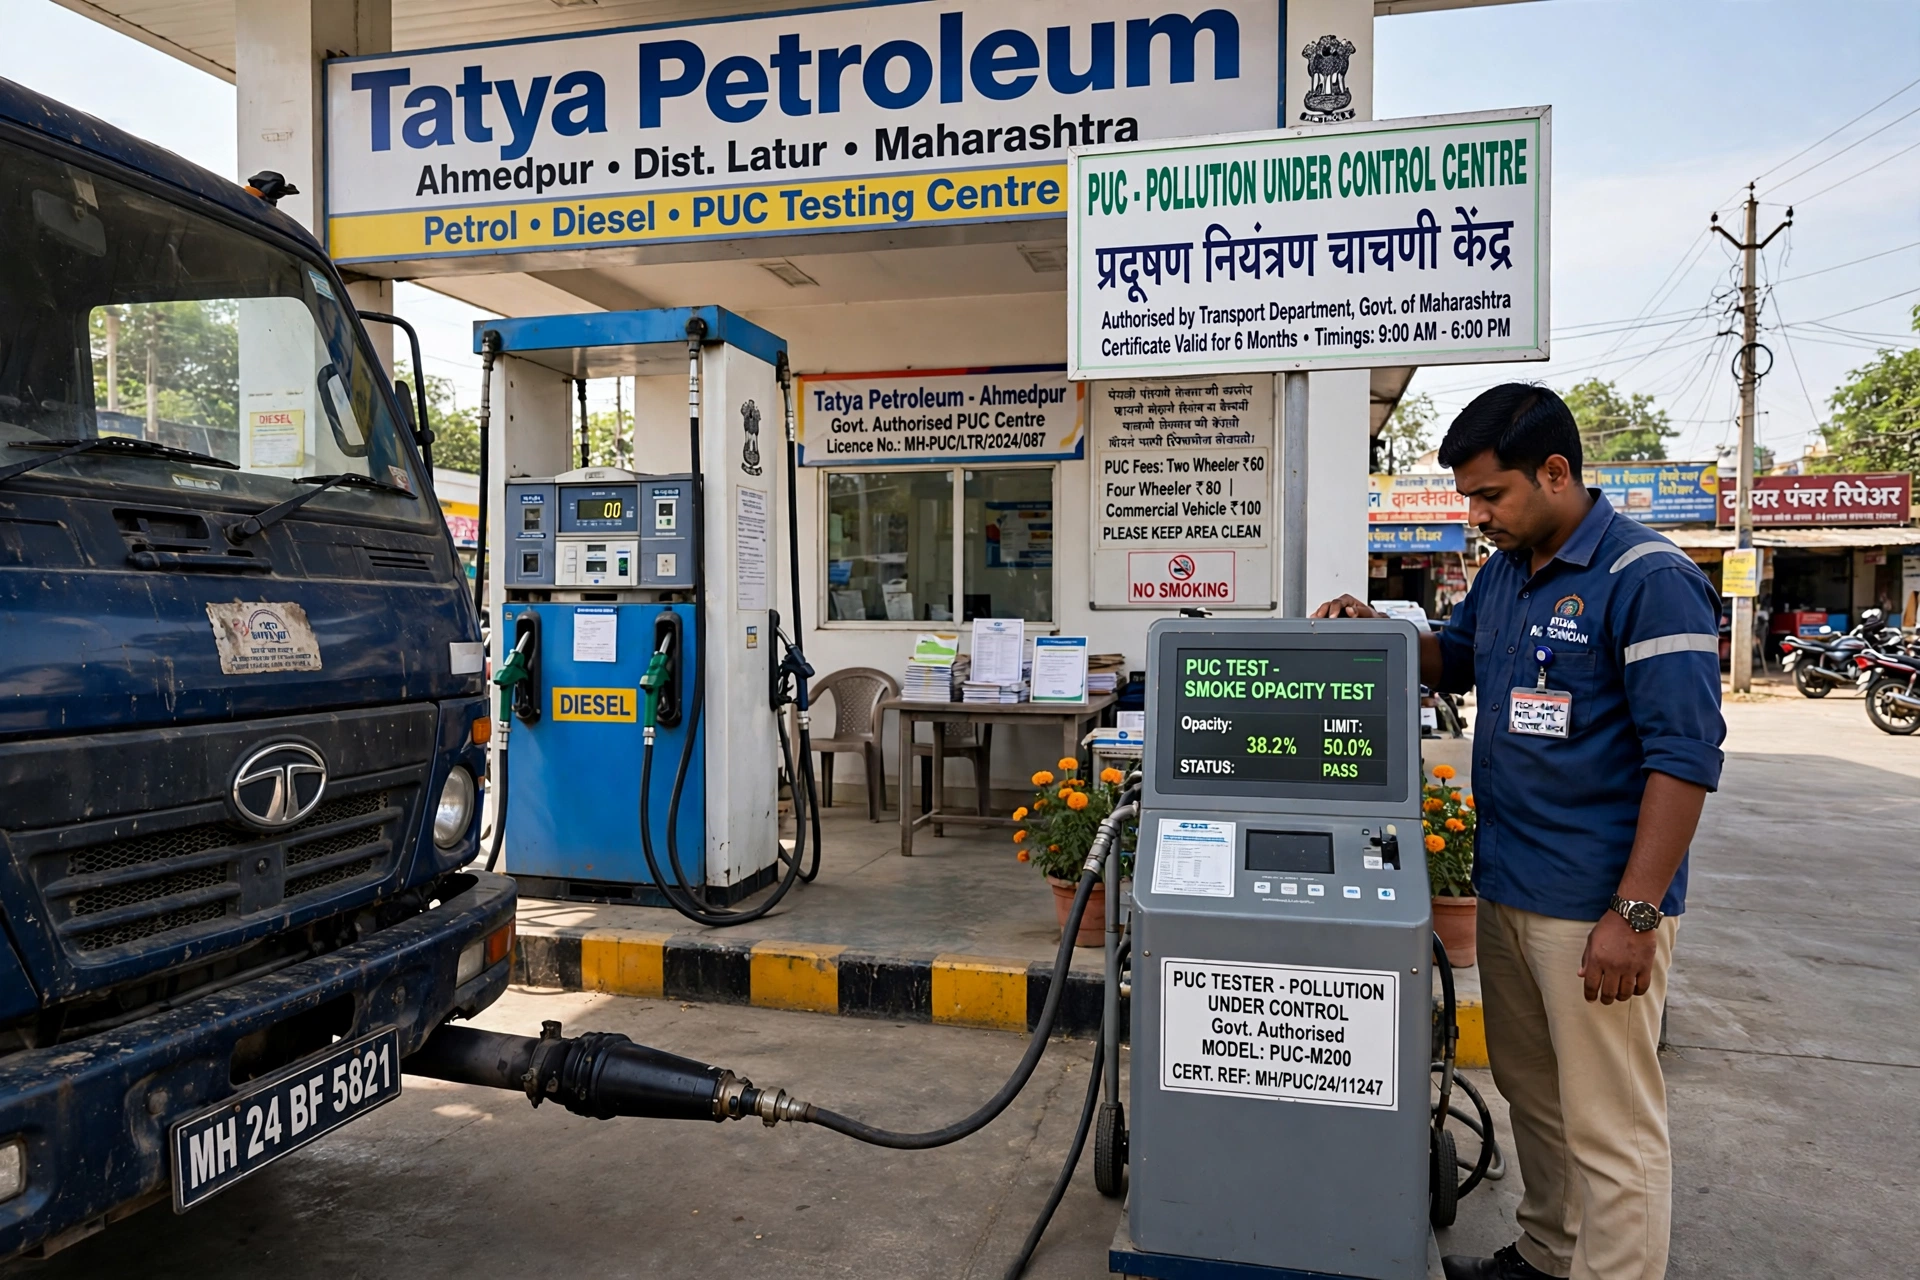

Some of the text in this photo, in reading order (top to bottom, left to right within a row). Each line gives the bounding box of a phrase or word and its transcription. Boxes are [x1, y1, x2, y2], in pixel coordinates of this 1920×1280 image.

[352, 8, 1240, 161] Tatya Petroleum
[416, 113, 1138, 196] Ahmedpur Dist. Latur Maharashtra
[1088, 168, 1127, 216] PUC
[1146, 160, 1257, 212] POLLUTION
[1263, 154, 1331, 203] UNDER
[1338, 146, 1436, 198] CONTROL
[1442, 138, 1528, 190] CENTRE
[424, 175, 1060, 246] Petrol Diesel PUC Testing Centre
[1096, 206, 1514, 303] प्रदूषण नियंत्रण चाचणी केंद्र
[1101, 290, 1511, 330] Authorised by Transport Department, Govt. of Maharashtra
[1101, 332, 1171, 357] Certificate
[1174, 330, 1208, 354] Valid
[1211, 329, 1231, 351] for
[1234, 328, 1243, 350] 6
[1247, 326, 1298, 350] Months
[1314, 322, 1374, 348] Timings:
[1378, 321, 1409, 343] 9:00
[1413, 320, 1437, 341] AM
[1451, 317, 1482, 340] 6:00
[1487, 316, 1511, 338] PM
[814, 390, 863, 415] Tatya
[869, 386, 964, 409] Petroleum
[980, 384, 1066, 408] Ahmedpur
[259, 414, 292, 424] DIESEL
[831, 411, 1045, 433] Govt. Authorised PUC Centre
[827, 432, 1046, 454] Licence No.: MH-PUC/LTR/2024/087
[1105, 460, 1129, 474] PUC
[1133, 459, 1163, 473] Fees:
[1166, 458, 1189, 472] Two
[1193, 457, 1239, 472] Wheeler
[1106, 483, 1135, 496] Four
[1139, 481, 1191, 496] Wheeler
[1783, 482, 1828, 508] पंचर
[1833, 480, 1902, 507] रिपेअर
[1106, 502, 1178, 517] Commercial
[1182, 501, 1226, 516] Vehicle
[1103, 525, 1261, 540] PLEASE KEEP AREA CLEAN
[1133, 582, 1229, 598] NO SMOKING
[1186, 659, 1221, 676] PUC
[1226, 659, 1269, 676] TEST
[1184, 680, 1375, 700] SMOKE OPACITY TEST
[560, 694, 630, 716] DIESEL
[1181, 716, 1232, 733] Opacity:
[1324, 719, 1363, 733] LIMIT:
[1246, 736, 1297, 755] 38.2%
[1323, 738, 1373, 756] 50.0%
[1180, 759, 1235, 774] STATUS:
[1323, 763, 1358, 778] PASS
[1173, 970, 1206, 988] PUC
[1211, 973, 1274, 993] TESTER
[1290, 979, 1384, 1001] POLLUTION
[1208, 995, 1349, 1021] UNDER CONTROL
[1211, 1018, 1345, 1043] Govt. Authorised
[1202, 1039, 1351, 1067] MODEL: PUC-M200
[1172, 1063, 1383, 1096] CERT. REF: MH/PUC/24/11247
[189, 1043, 391, 1190] MH 24 BF 5821
